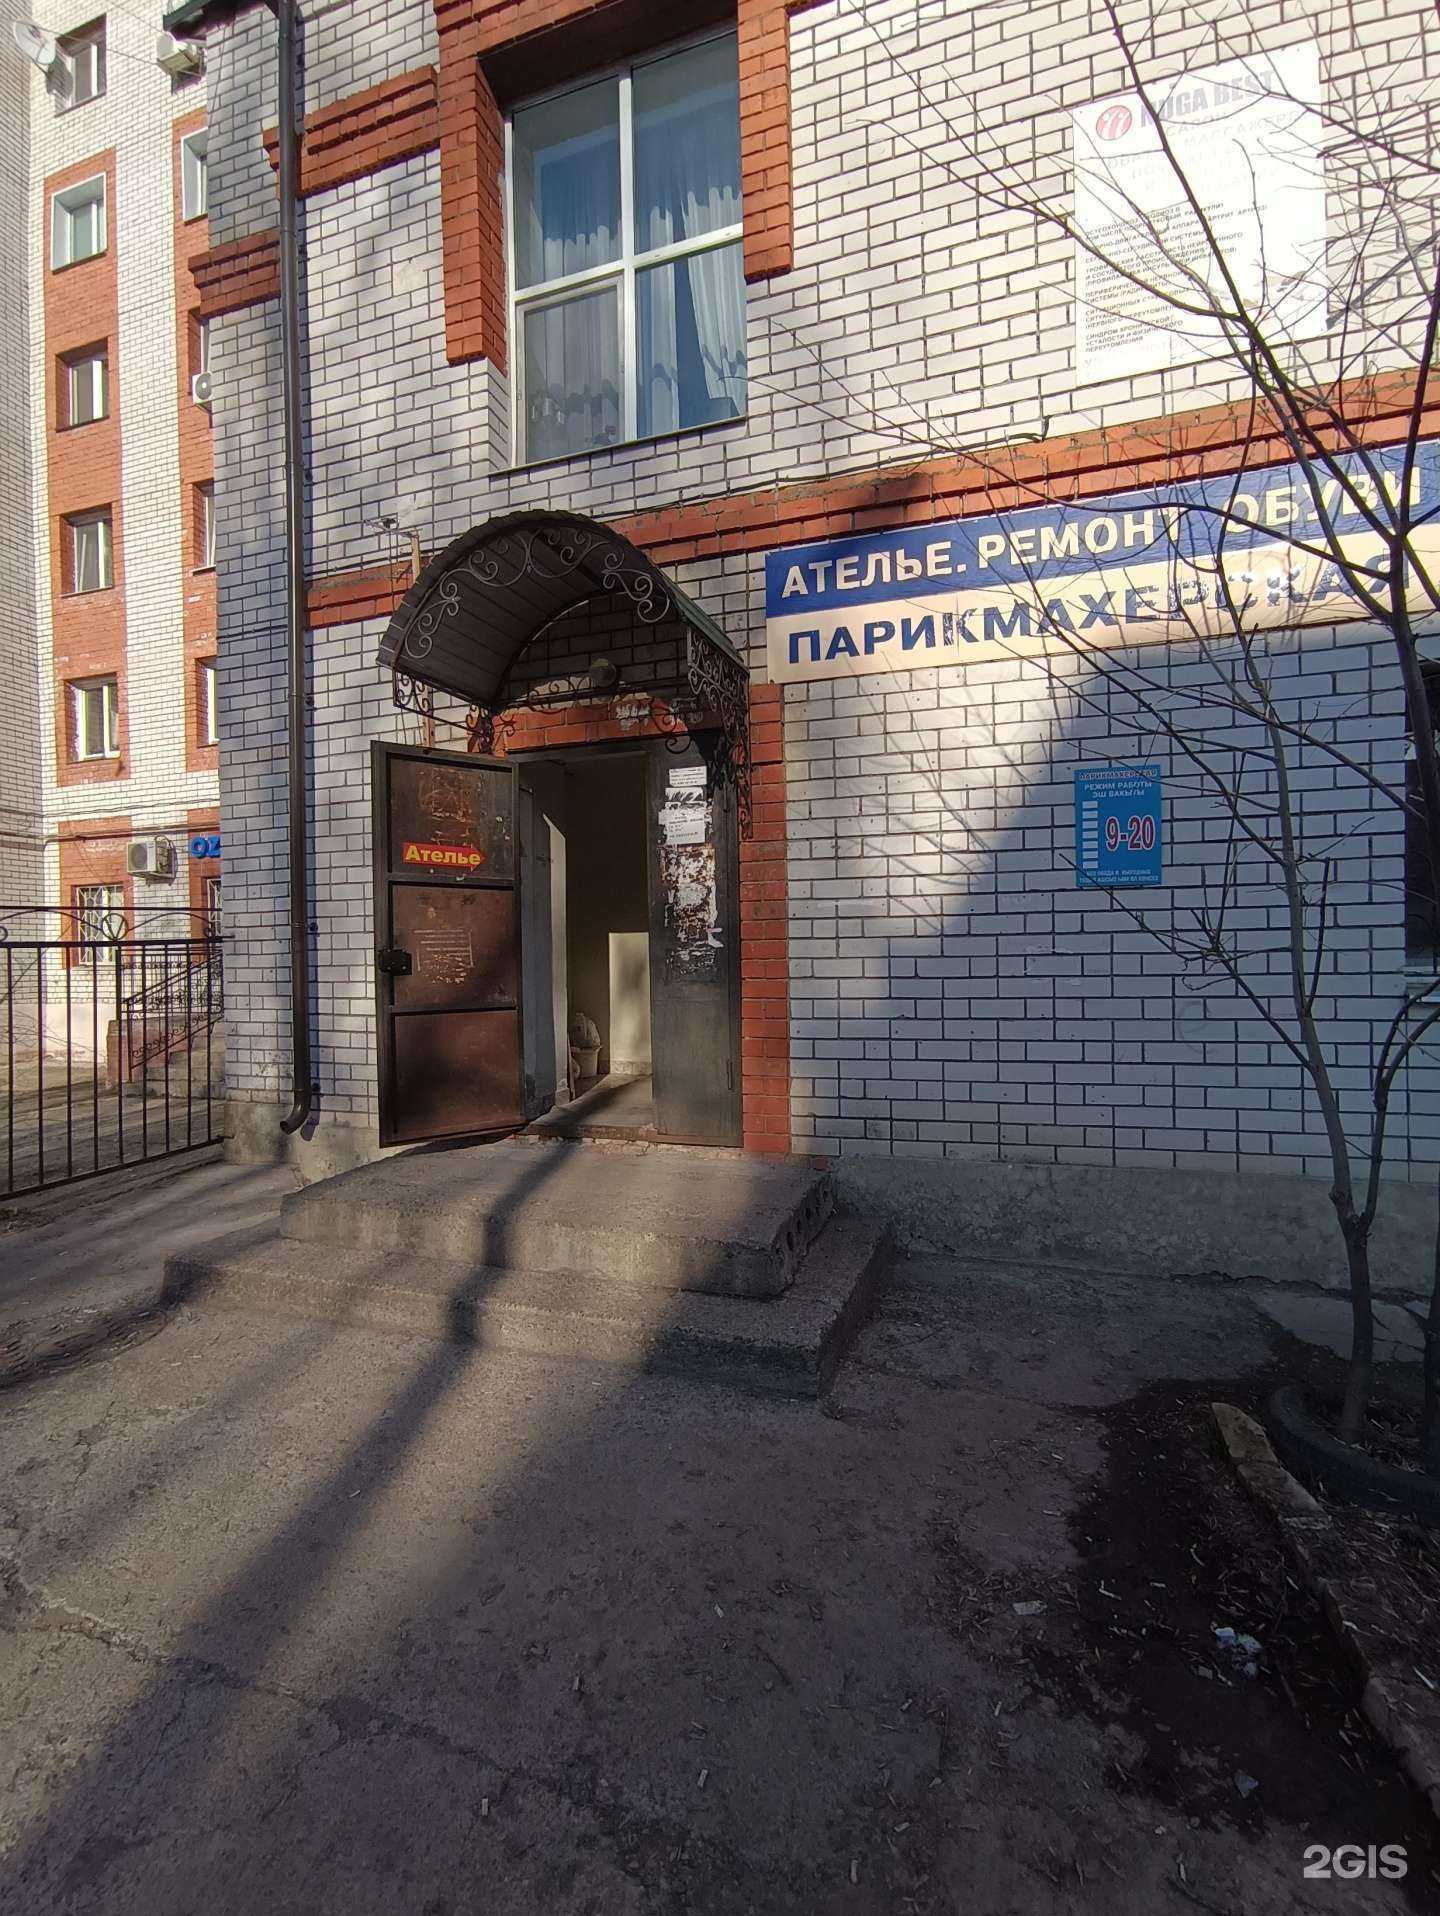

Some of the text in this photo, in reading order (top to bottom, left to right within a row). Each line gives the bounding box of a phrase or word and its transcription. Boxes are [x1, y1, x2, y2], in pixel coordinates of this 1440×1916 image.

[782, 466, 1421, 599] АТЕЛЬЕ. РЕМОНТ ОБУВИ
[1105, 815, 1156, 851] 9-20
[405, 845, 481, 866] Ателье
